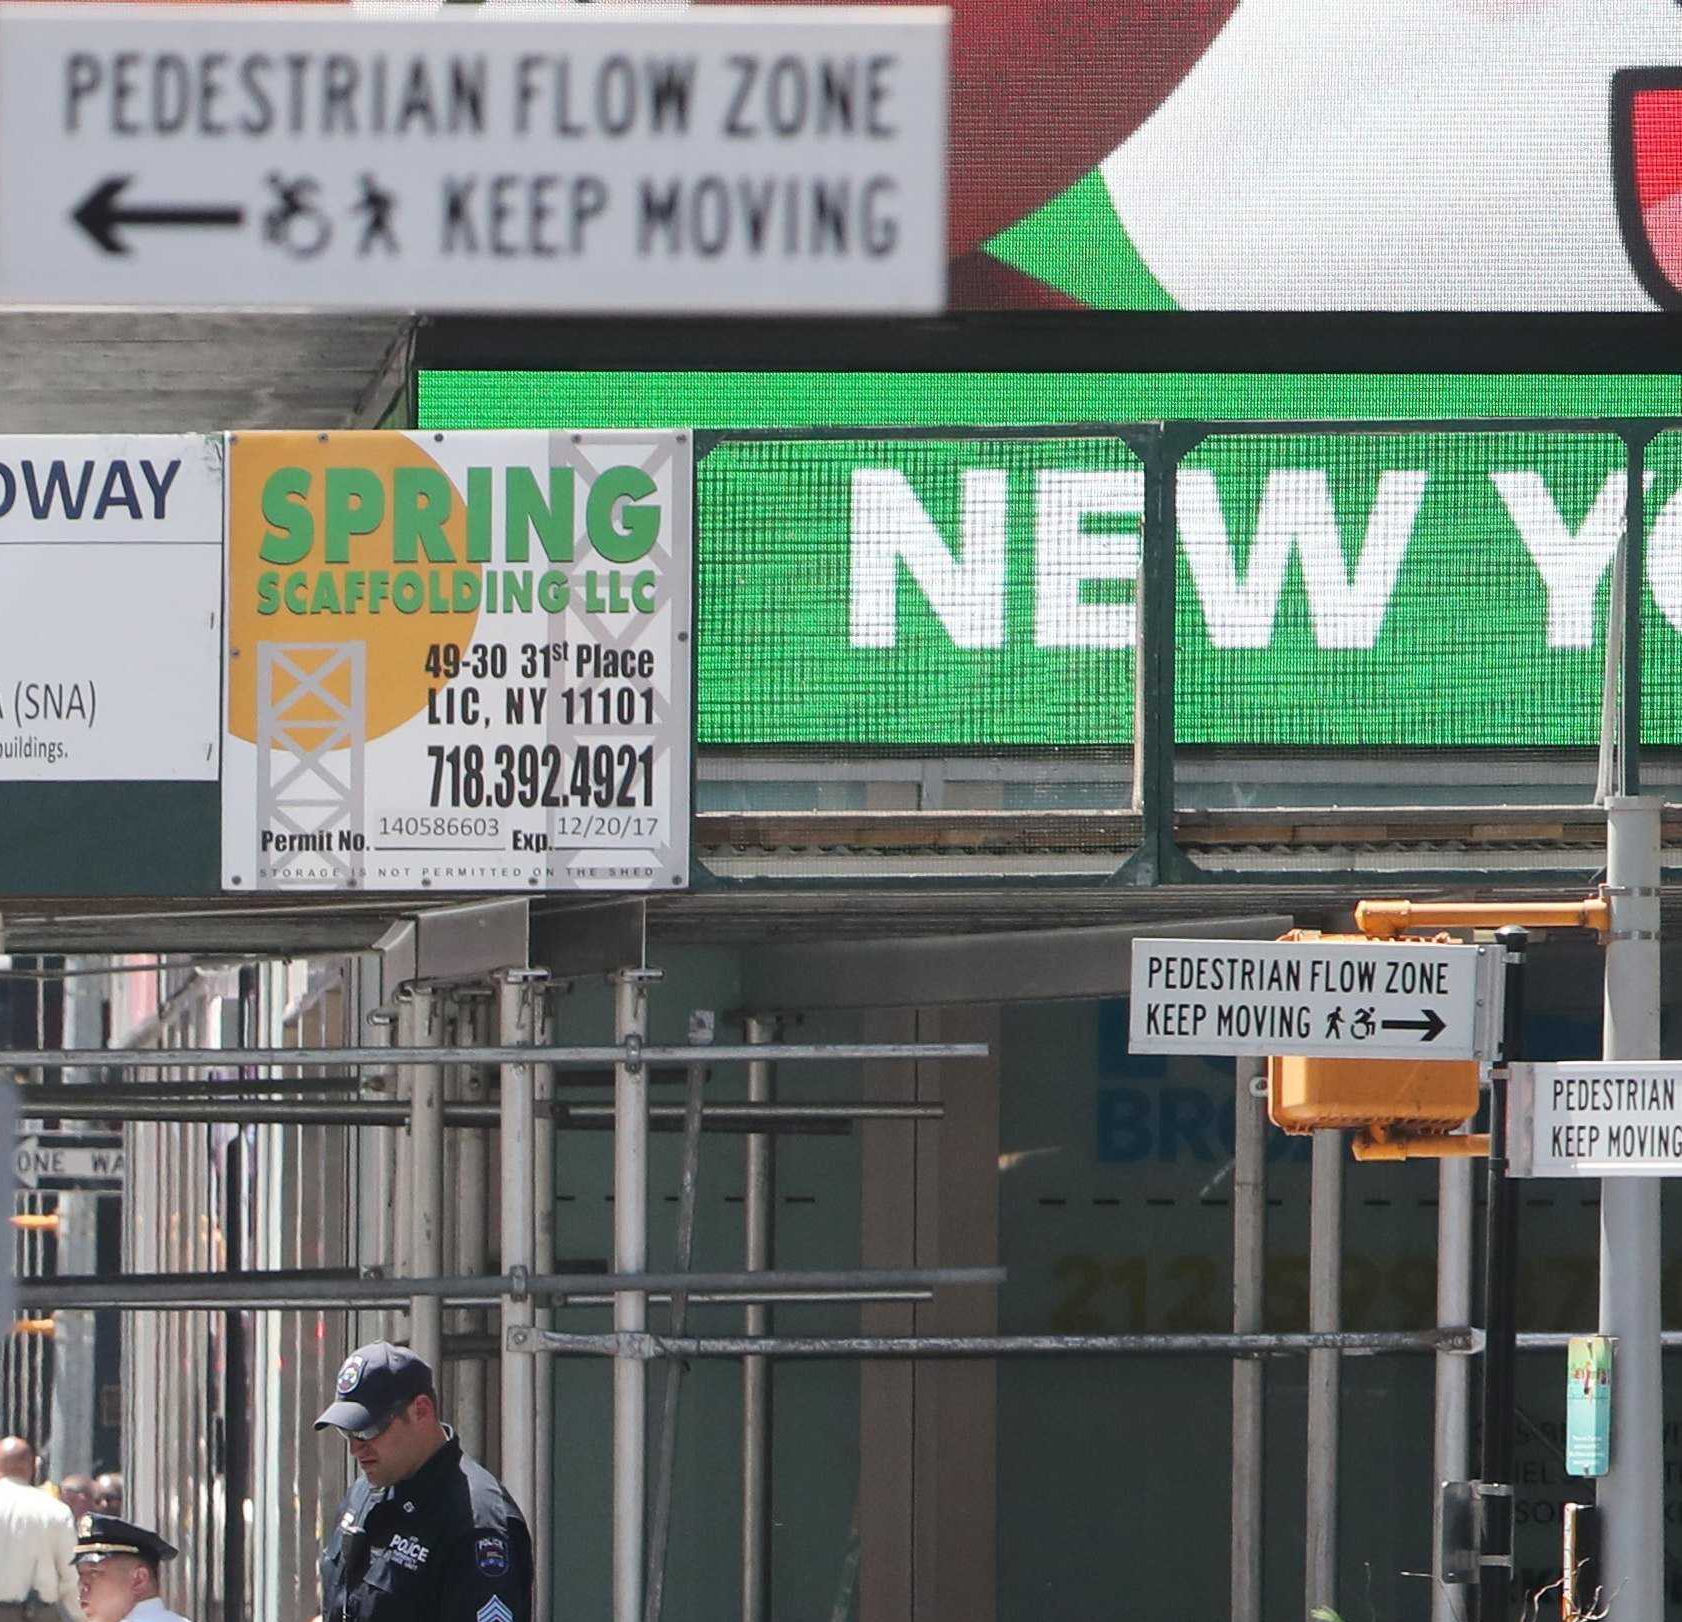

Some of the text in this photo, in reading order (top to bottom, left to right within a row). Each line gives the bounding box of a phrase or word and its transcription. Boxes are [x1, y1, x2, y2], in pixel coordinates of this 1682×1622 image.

[64, 54, 901, 138] PEDESTRIAN FLOW ZONE
[438, 175, 901, 259] KEEP MOVING
[258, 464, 662, 567] SPRING
[848, 467, 1682, 651] NEW Y
[256, 570, 656, 616] SCAFFOLDING LLC
[424, 639, 655, 680] 49-30 31st Place
[14, 679, 97, 728] (SNA)
[427, 686, 655, 730] LIC, NY 11101
[427, 743, 654, 809] 718.392.4921
[261, 828, 554, 857] Permit No. Exp.
[378, 815, 658, 839] 140586603 12/20/17
[260, 867, 655, 878] STORAGE IS NOT PERMITTED ON THE SHED
[1148, 956, 1449, 995] PEDESTRIAN FLOW ZONE
[1146, 1003, 1206, 1036] KEEP
[1217, 1005, 1311, 1039] MOVING
[1552, 1079, 1675, 1111] PEDESTRIAN
[17, 1150, 125, 1173] ONE WA
[1551, 1125, 1682, 1158] KEEP MOVING
[389, 1533, 430, 1563] POLICE
